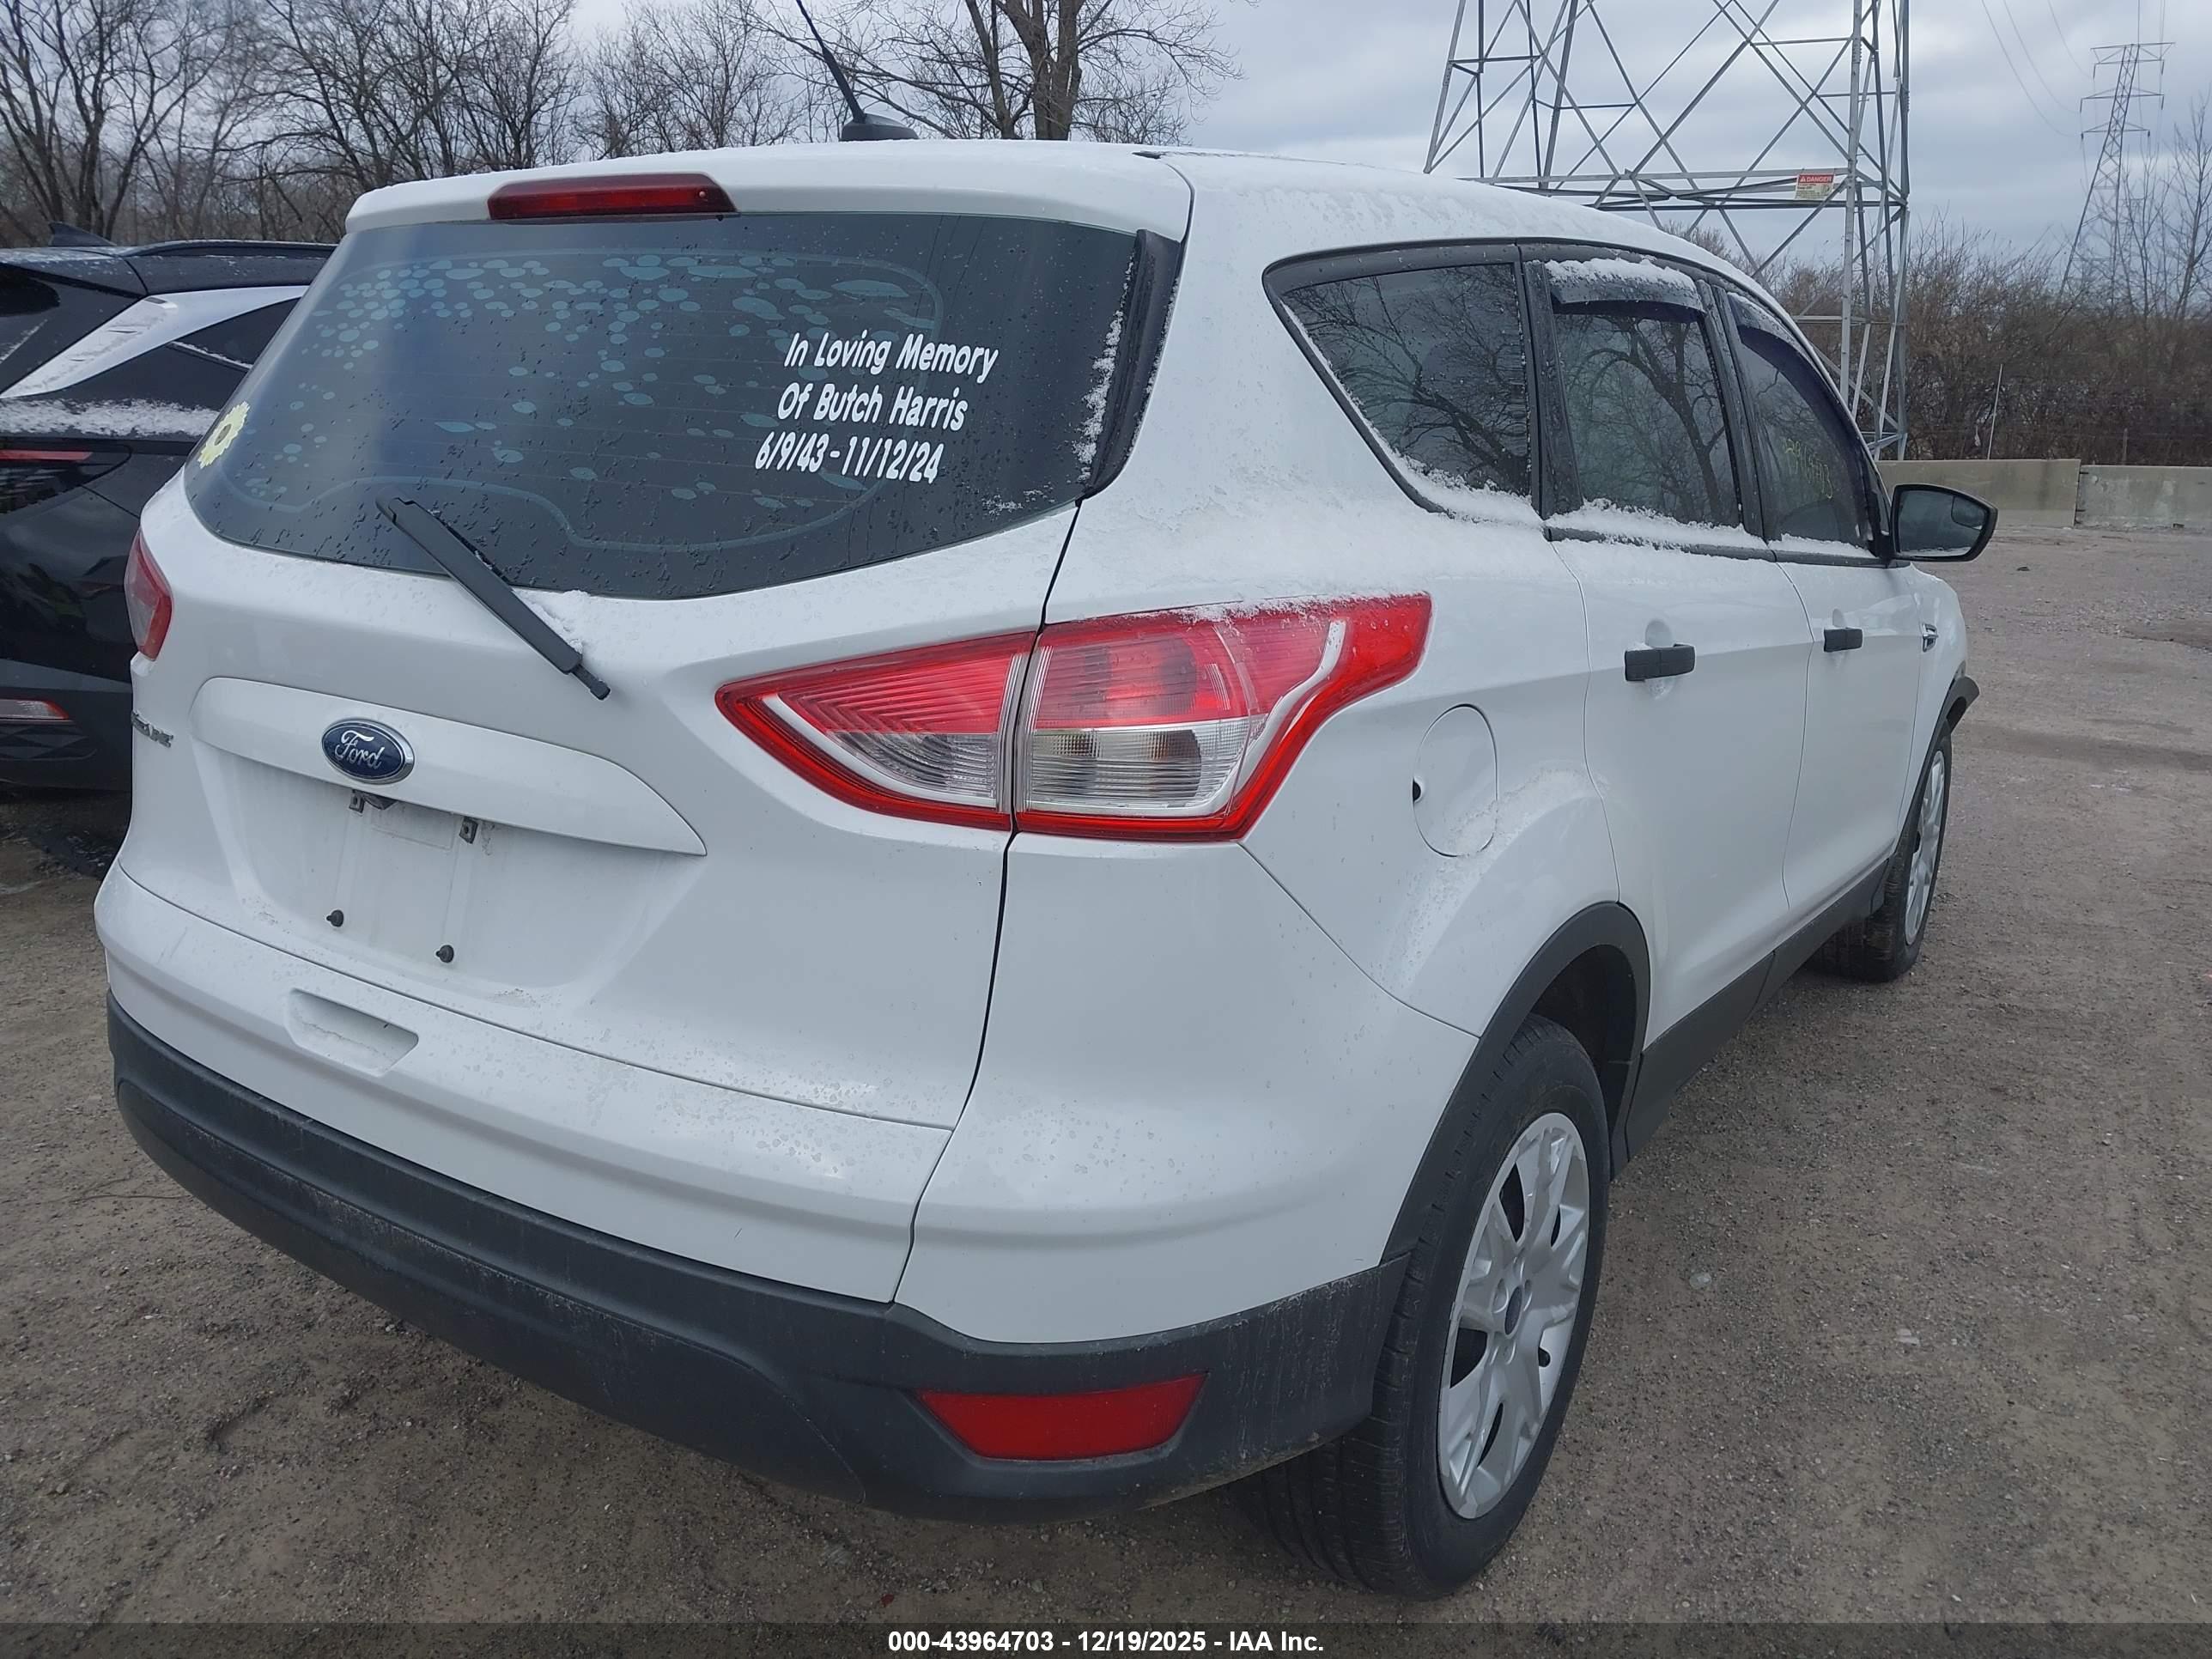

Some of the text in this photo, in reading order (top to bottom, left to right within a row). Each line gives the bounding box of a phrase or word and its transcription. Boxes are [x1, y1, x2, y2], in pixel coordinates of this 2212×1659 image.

[783, 329, 999, 384] In Loving Memory
[777, 382, 969, 431] Of Butch Harris
[333, 729, 386, 771] Ford
